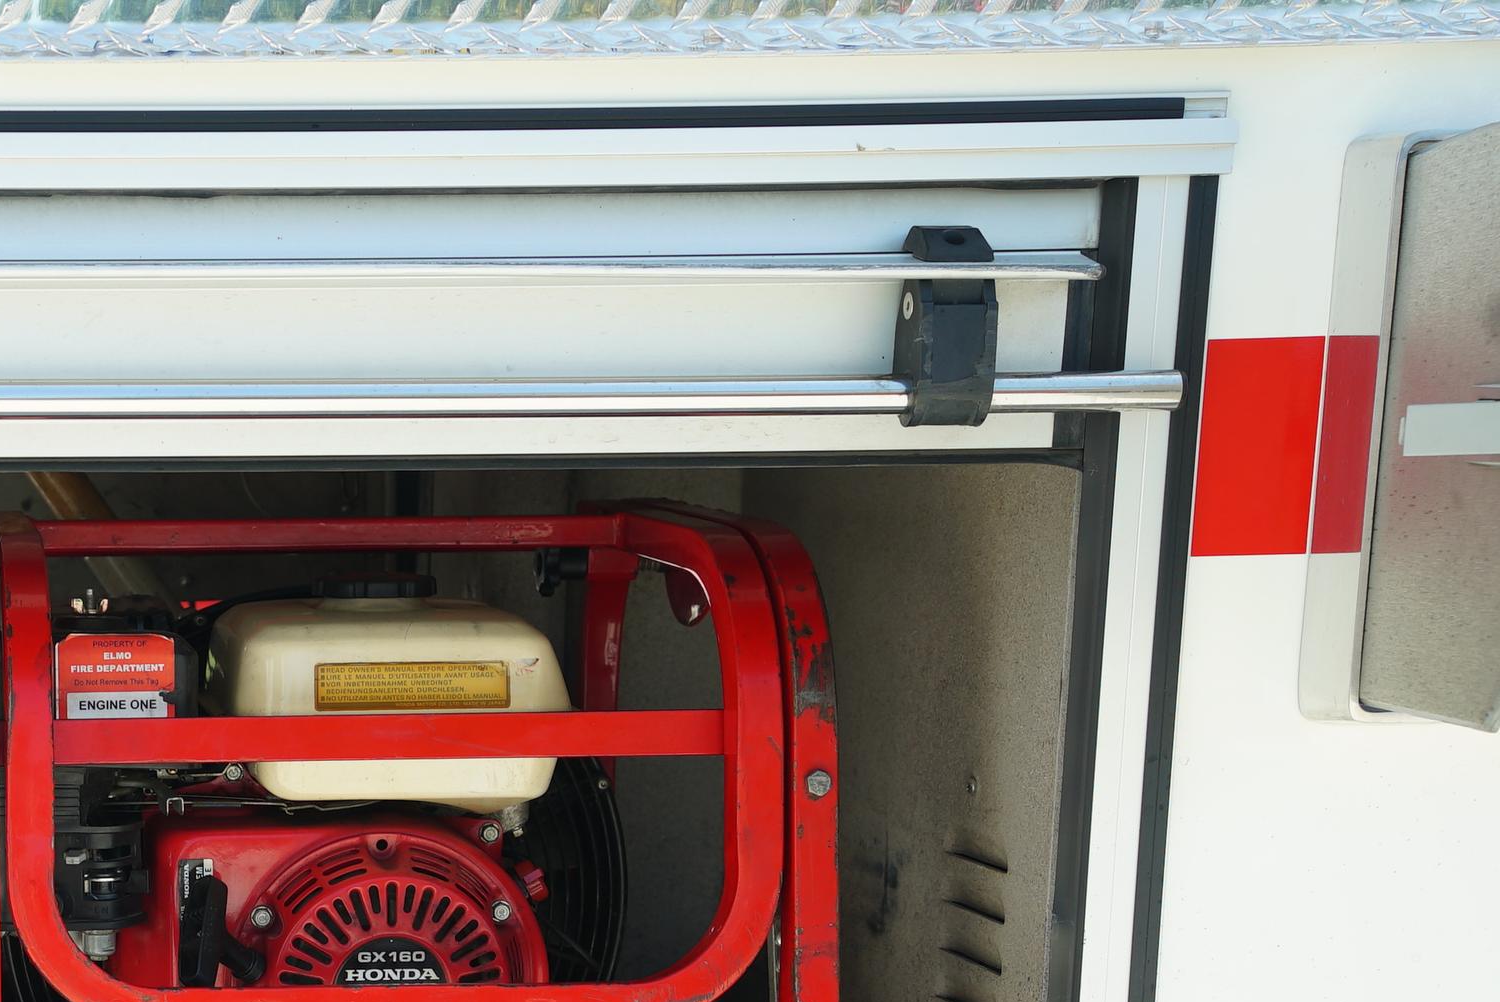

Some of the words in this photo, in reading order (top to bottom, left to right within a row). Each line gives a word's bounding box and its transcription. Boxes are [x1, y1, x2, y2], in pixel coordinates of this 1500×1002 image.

[92, 640, 133, 648] PROPERTY
[103, 652, 132, 660] ELMO
[70, 665, 94, 673] FIRE
[96, 663, 165, 673] DEPARTMENT
[99, 678, 128, 686] Remove
[146, 677, 159, 686] Tag
[79, 699, 127, 711] ENGINE
[130, 699, 157, 711] ONE
[357, 951, 426, 963] GX160
[345, 968, 440, 981] HONDA
